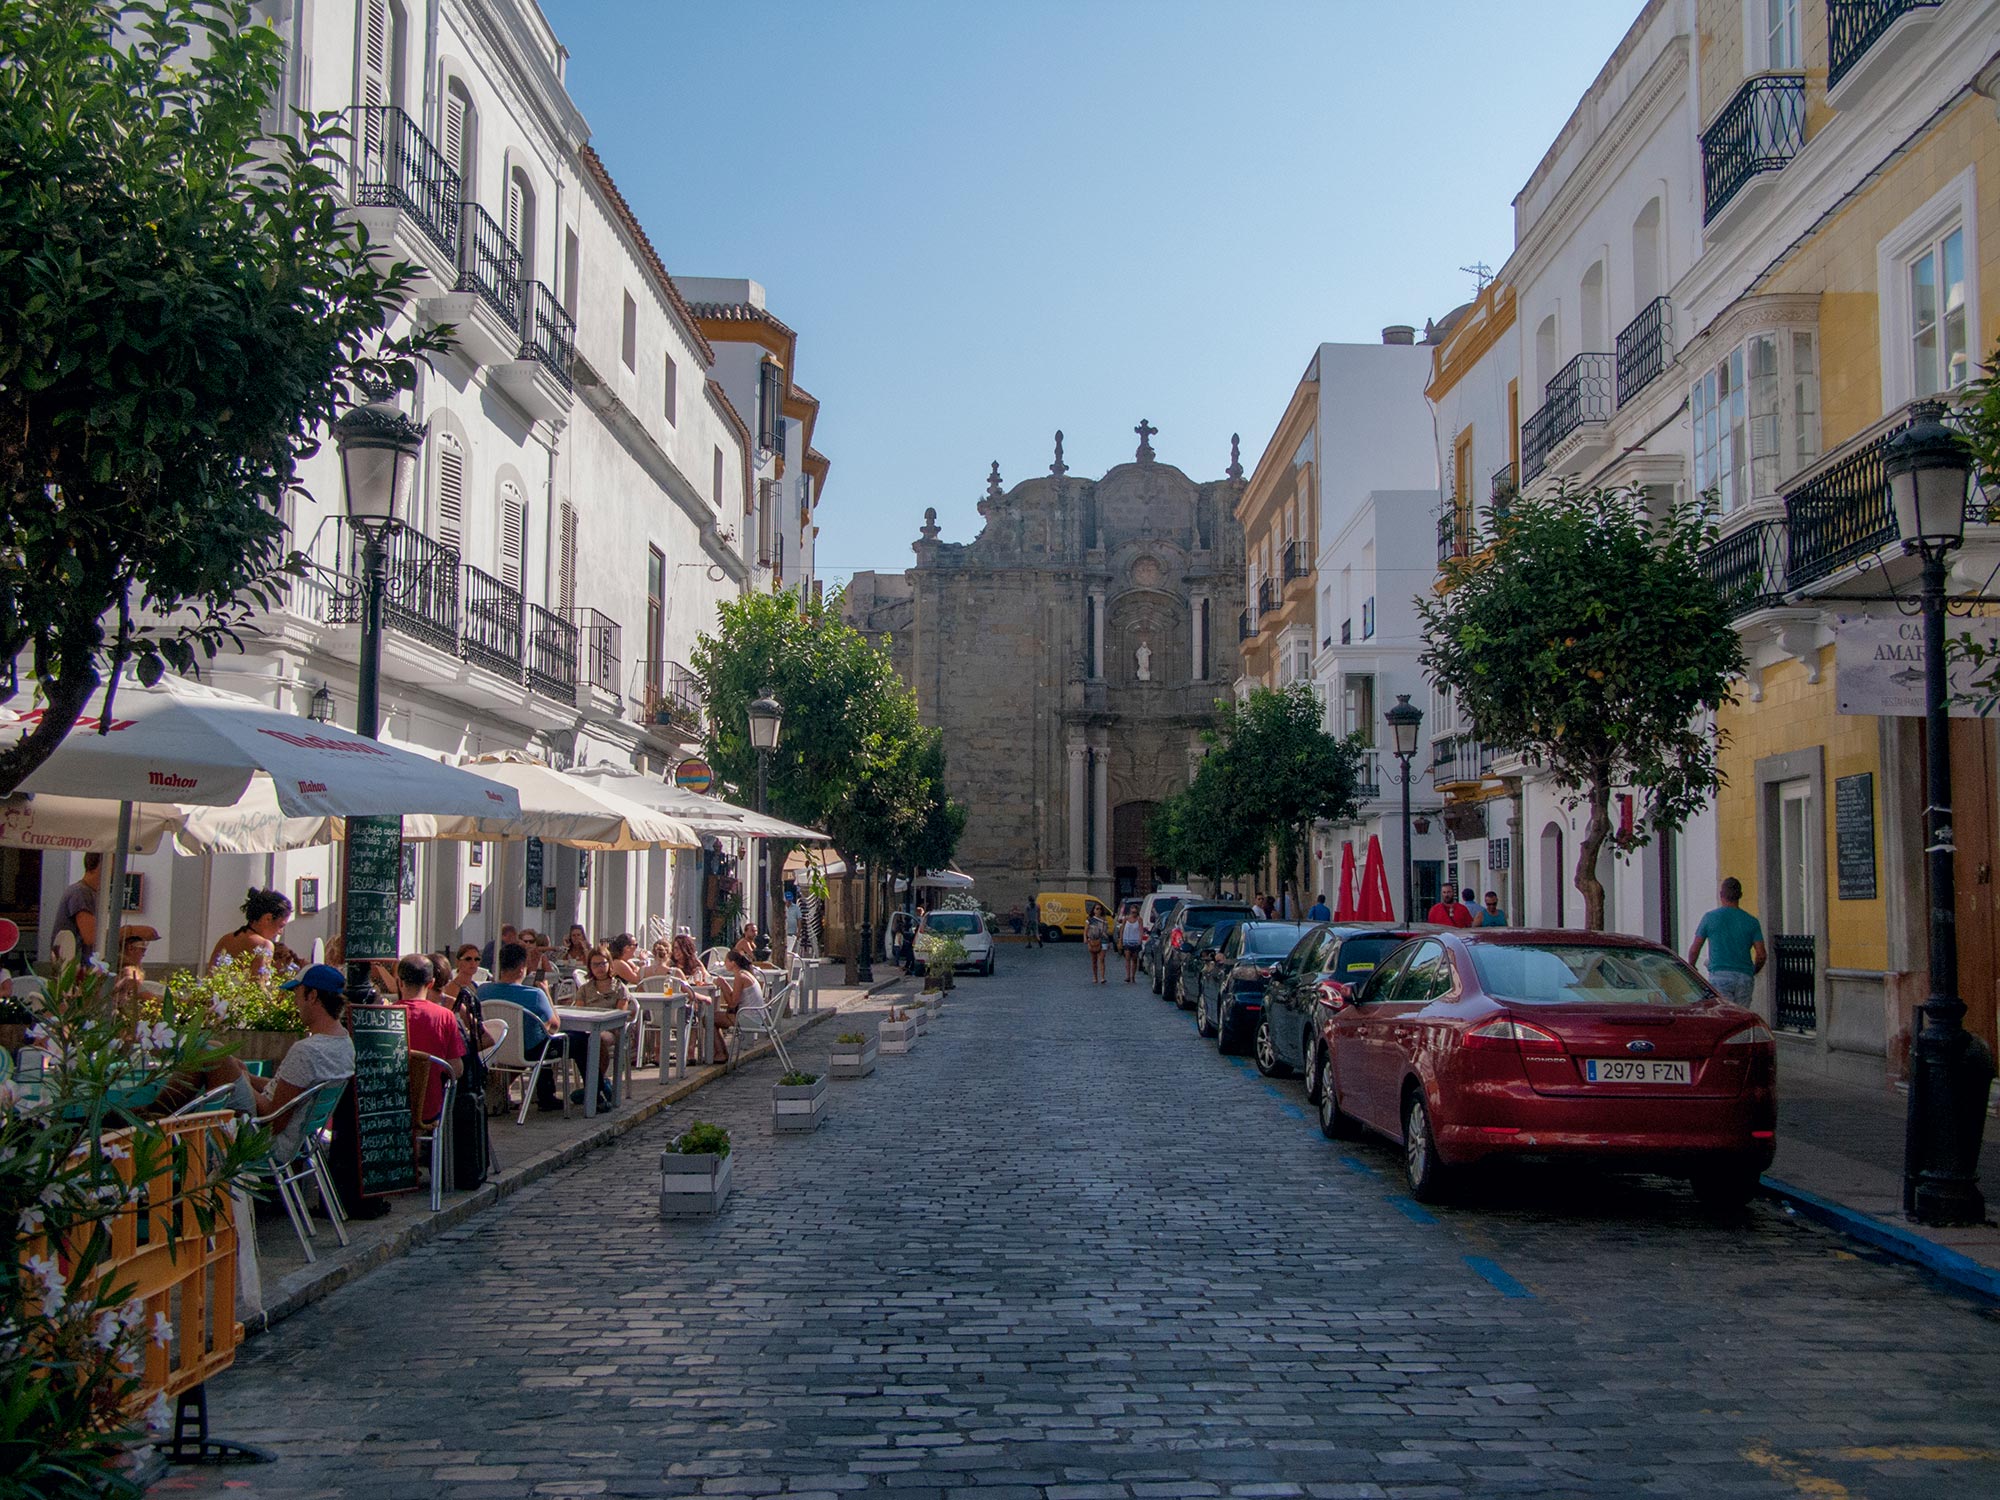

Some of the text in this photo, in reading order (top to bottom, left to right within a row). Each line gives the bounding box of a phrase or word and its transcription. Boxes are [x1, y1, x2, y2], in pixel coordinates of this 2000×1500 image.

[148, 771, 198, 788] Mahou
[298, 780, 327, 794] Mahou
[22, 831, 92, 848] Cruzcampo
[352, 1010, 386, 1026] SPECIALS
[1603, 1063, 1645, 1079] 2979
[1653, 1064, 1684, 1080] FZN
[359, 1097, 376, 1111] FISH
